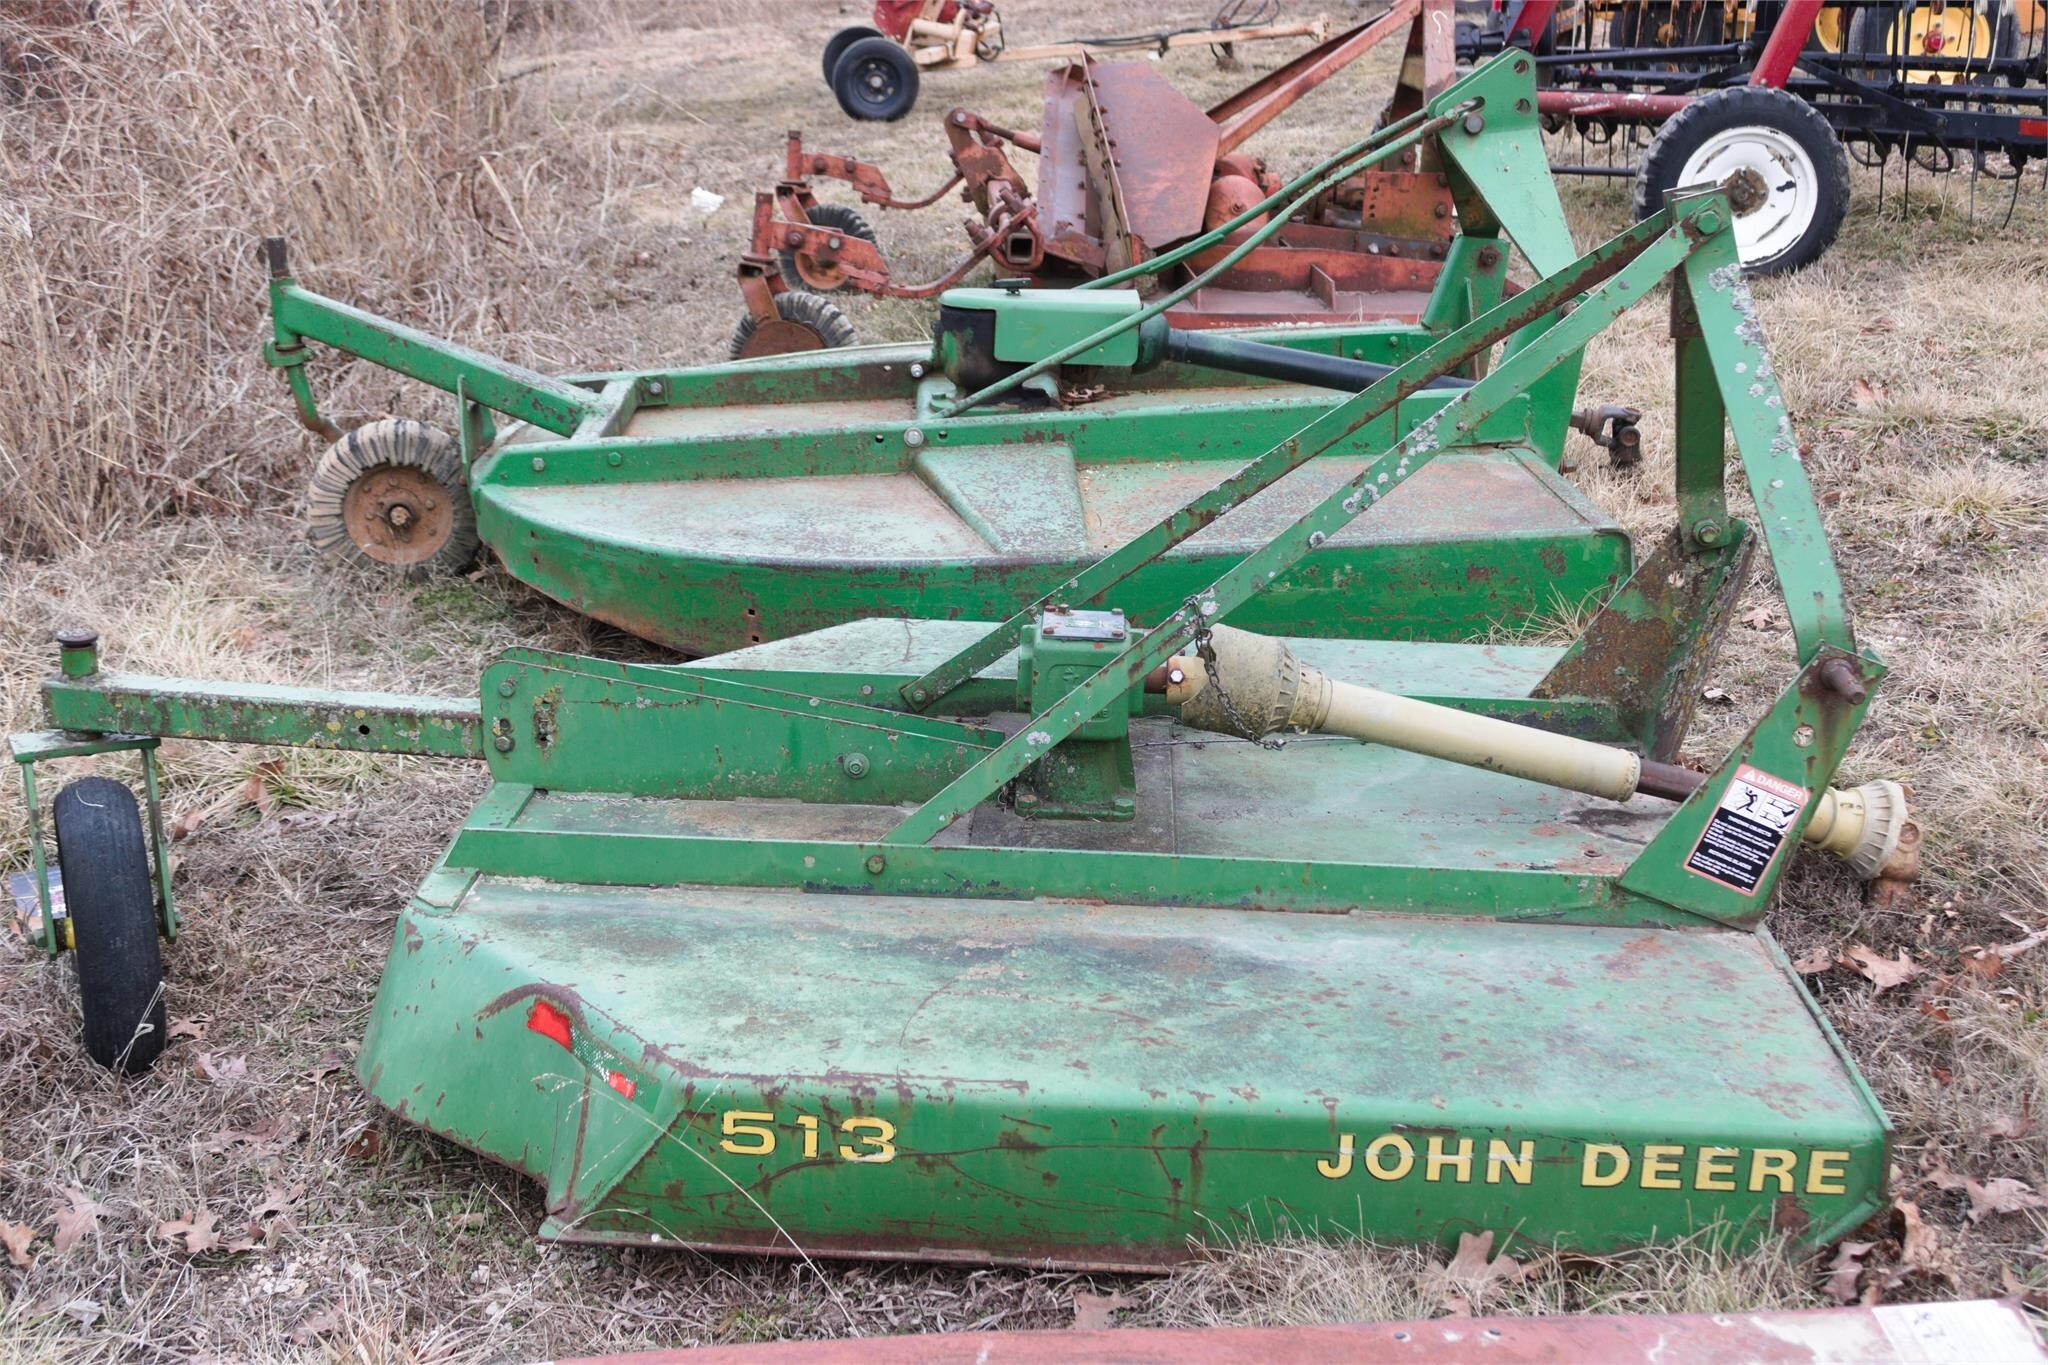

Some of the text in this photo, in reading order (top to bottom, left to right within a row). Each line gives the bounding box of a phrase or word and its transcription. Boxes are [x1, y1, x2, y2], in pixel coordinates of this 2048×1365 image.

[1756, 775, 1803, 801] DANGER
[719, 1110, 898, 1164] 513
[1316, 1132, 1851, 1195] JOHN DEERE
